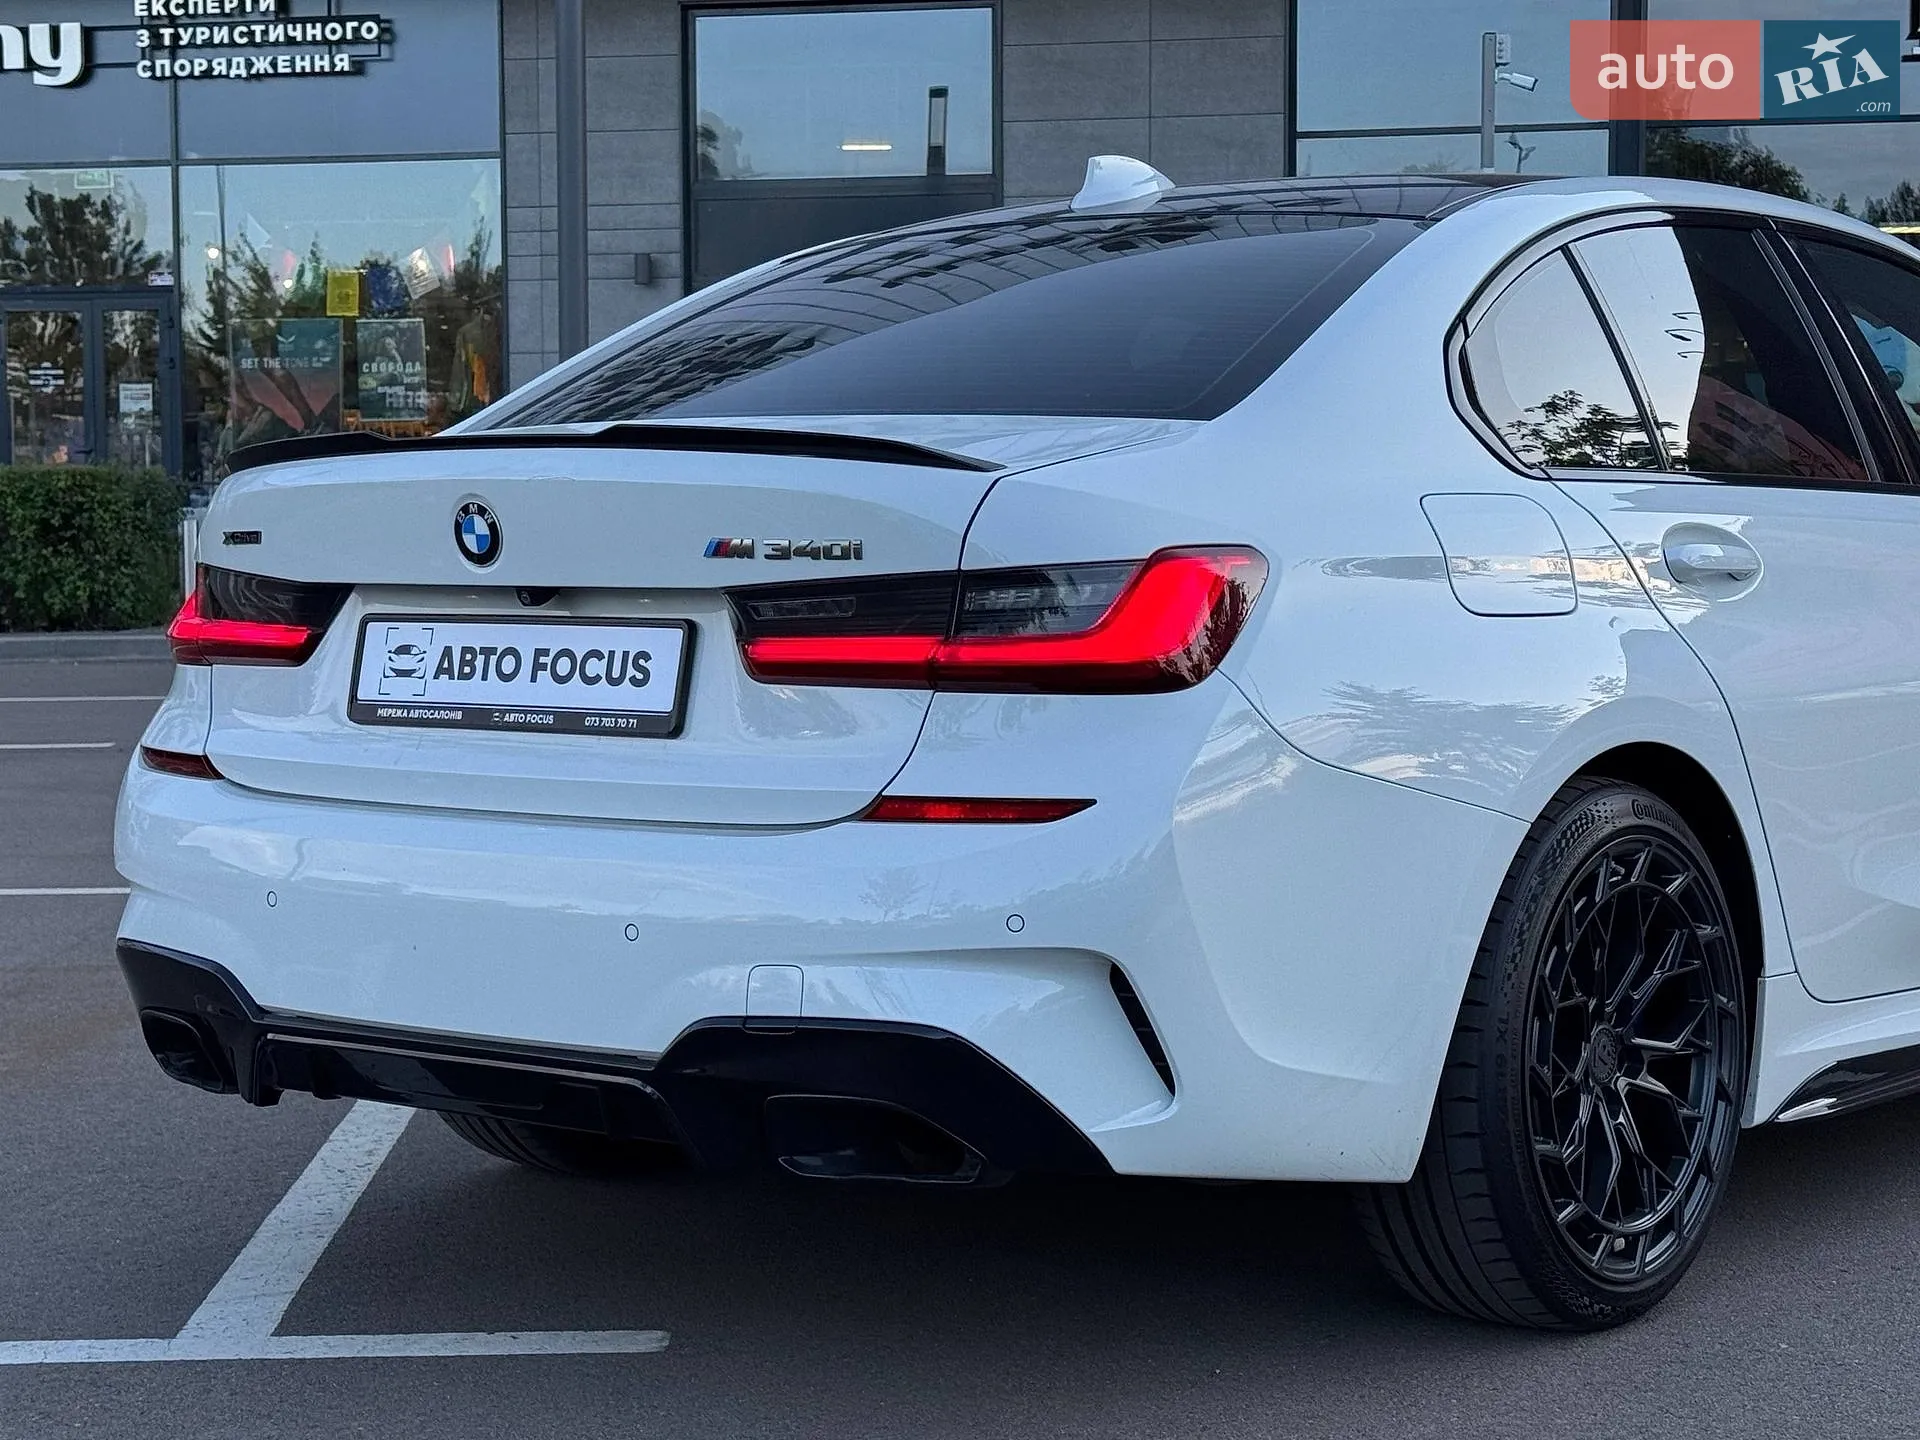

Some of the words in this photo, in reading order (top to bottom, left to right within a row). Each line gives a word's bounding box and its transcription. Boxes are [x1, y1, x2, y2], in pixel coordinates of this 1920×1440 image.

[134, 0, 276, 17] ЕКСПЕРТИ
[160, 21, 380, 47] ТУРИСТИЧНОГО
[136, 53, 351, 79] СПОРЯДЖЕННЯ
[457, 503, 494, 524] BMW
[763, 539, 864, 561] 340i
[529, 648, 652, 688] FOCUS
[377, 707, 408, 719] МЕРЕЖА
[408, 709, 463, 721] АВТОСАЛОНІВ
[526, 713, 554, 724] FOCUS
[584, 717, 600, 726] 073
[600, 717, 616, 727] 703
[616, 718, 627, 728] 70
[628, 719, 638, 728] 71
